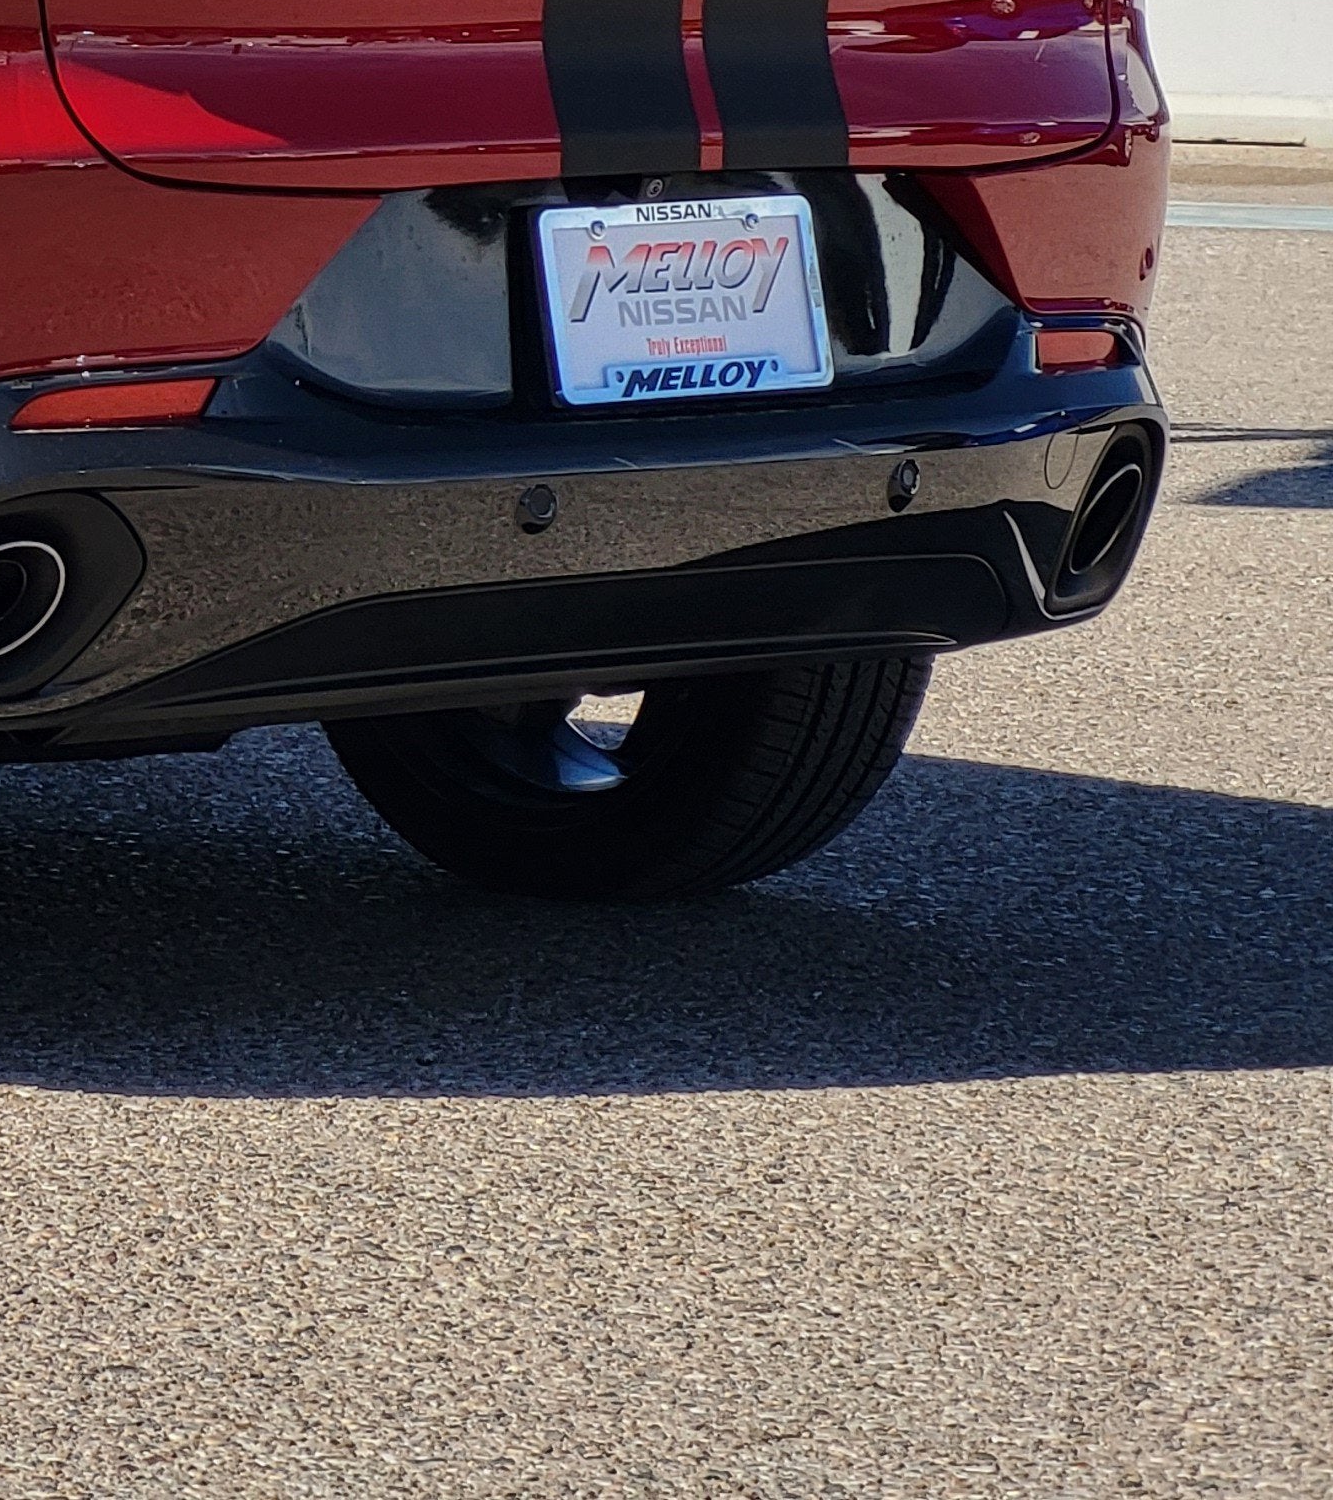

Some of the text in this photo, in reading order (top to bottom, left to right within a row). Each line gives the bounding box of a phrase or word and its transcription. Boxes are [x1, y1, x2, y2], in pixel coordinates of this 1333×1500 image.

[635, 202, 713, 223] NISSAN
[568, 236, 790, 323] MELLOY
[618, 295, 748, 328] NISSAN
[646, 335, 728, 357] Truly Exceptional
[622, 359, 766, 398] MELLOY
